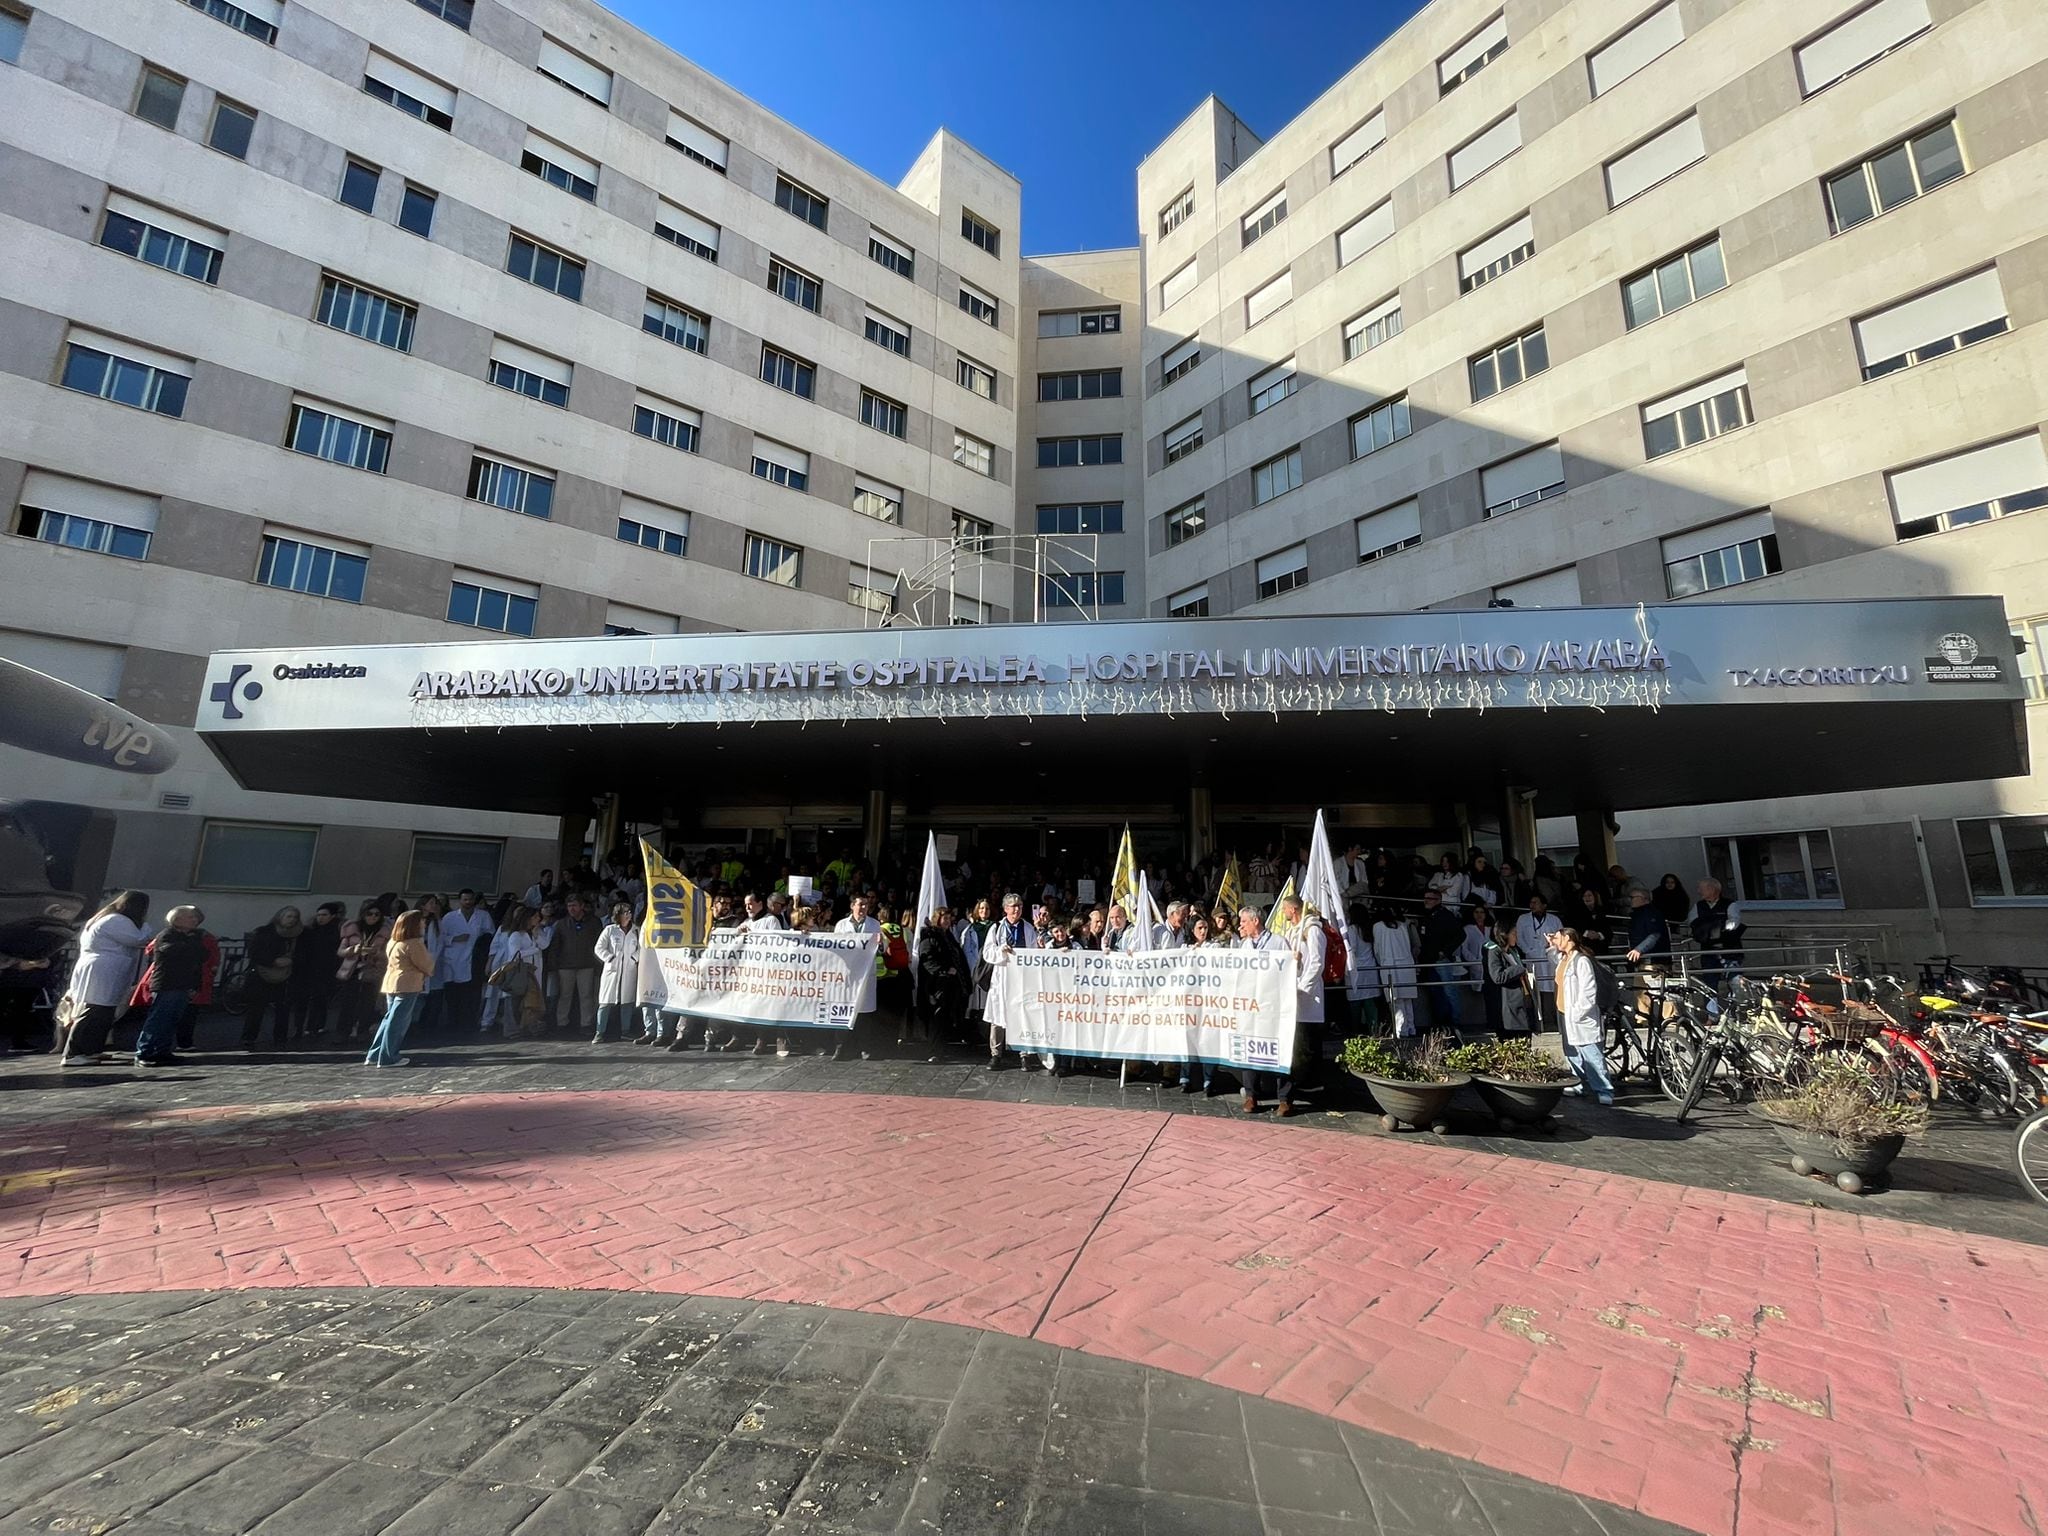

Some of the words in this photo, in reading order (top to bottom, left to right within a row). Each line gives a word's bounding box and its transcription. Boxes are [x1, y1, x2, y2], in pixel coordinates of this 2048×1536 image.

[273, 662, 367, 681] Osakidetza
[409, 667, 566, 699] ARABAKO
[574, 659, 838, 695] UNIBERTSITATE
[846, 654, 1047, 687] OSPITALEA
[1067, 649, 1236, 681] HOSPITAL
[1244, 640, 1526, 676] UNIVERSITARIO
[1536, 637, 1672, 673] ARABA
[1726, 664, 1909, 688] TXAGORRITXU
[861, 940, 869, 950] Y
[765, 952, 812, 964] PROPIO
[1016, 955, 1079, 970] EUSKADI,
[1084, 957, 1113, 970] POR
[1137, 955, 1207, 970] ESTATUTO
[1211, 953, 1270, 970] MÉDICO
[1275, 958, 1286, 971] Y
[708, 966, 764, 978] ESTATUTU
[767, 970, 817, 982] MEDIKO
[821, 973, 845, 983] ETA
[1073, 974, 1166, 988] FACULTATIVO
[1170, 974, 1222, 988] PROPIO
[676, 975, 748, 993] FAKULTATIBO
[750, 986, 787, 997] BATEN
[790, 989, 825, 999] ALDE
[1037, 991, 1100, 1007] EUSKADI,
[1174, 994, 1228, 1009] MEDIKO
[1232, 997, 1260, 1012] ETA
[1155, 1013, 1198, 1026] BATEN
[1201, 1014, 1238, 1030] ALDE
[1247, 1040, 1278, 1056] SME
